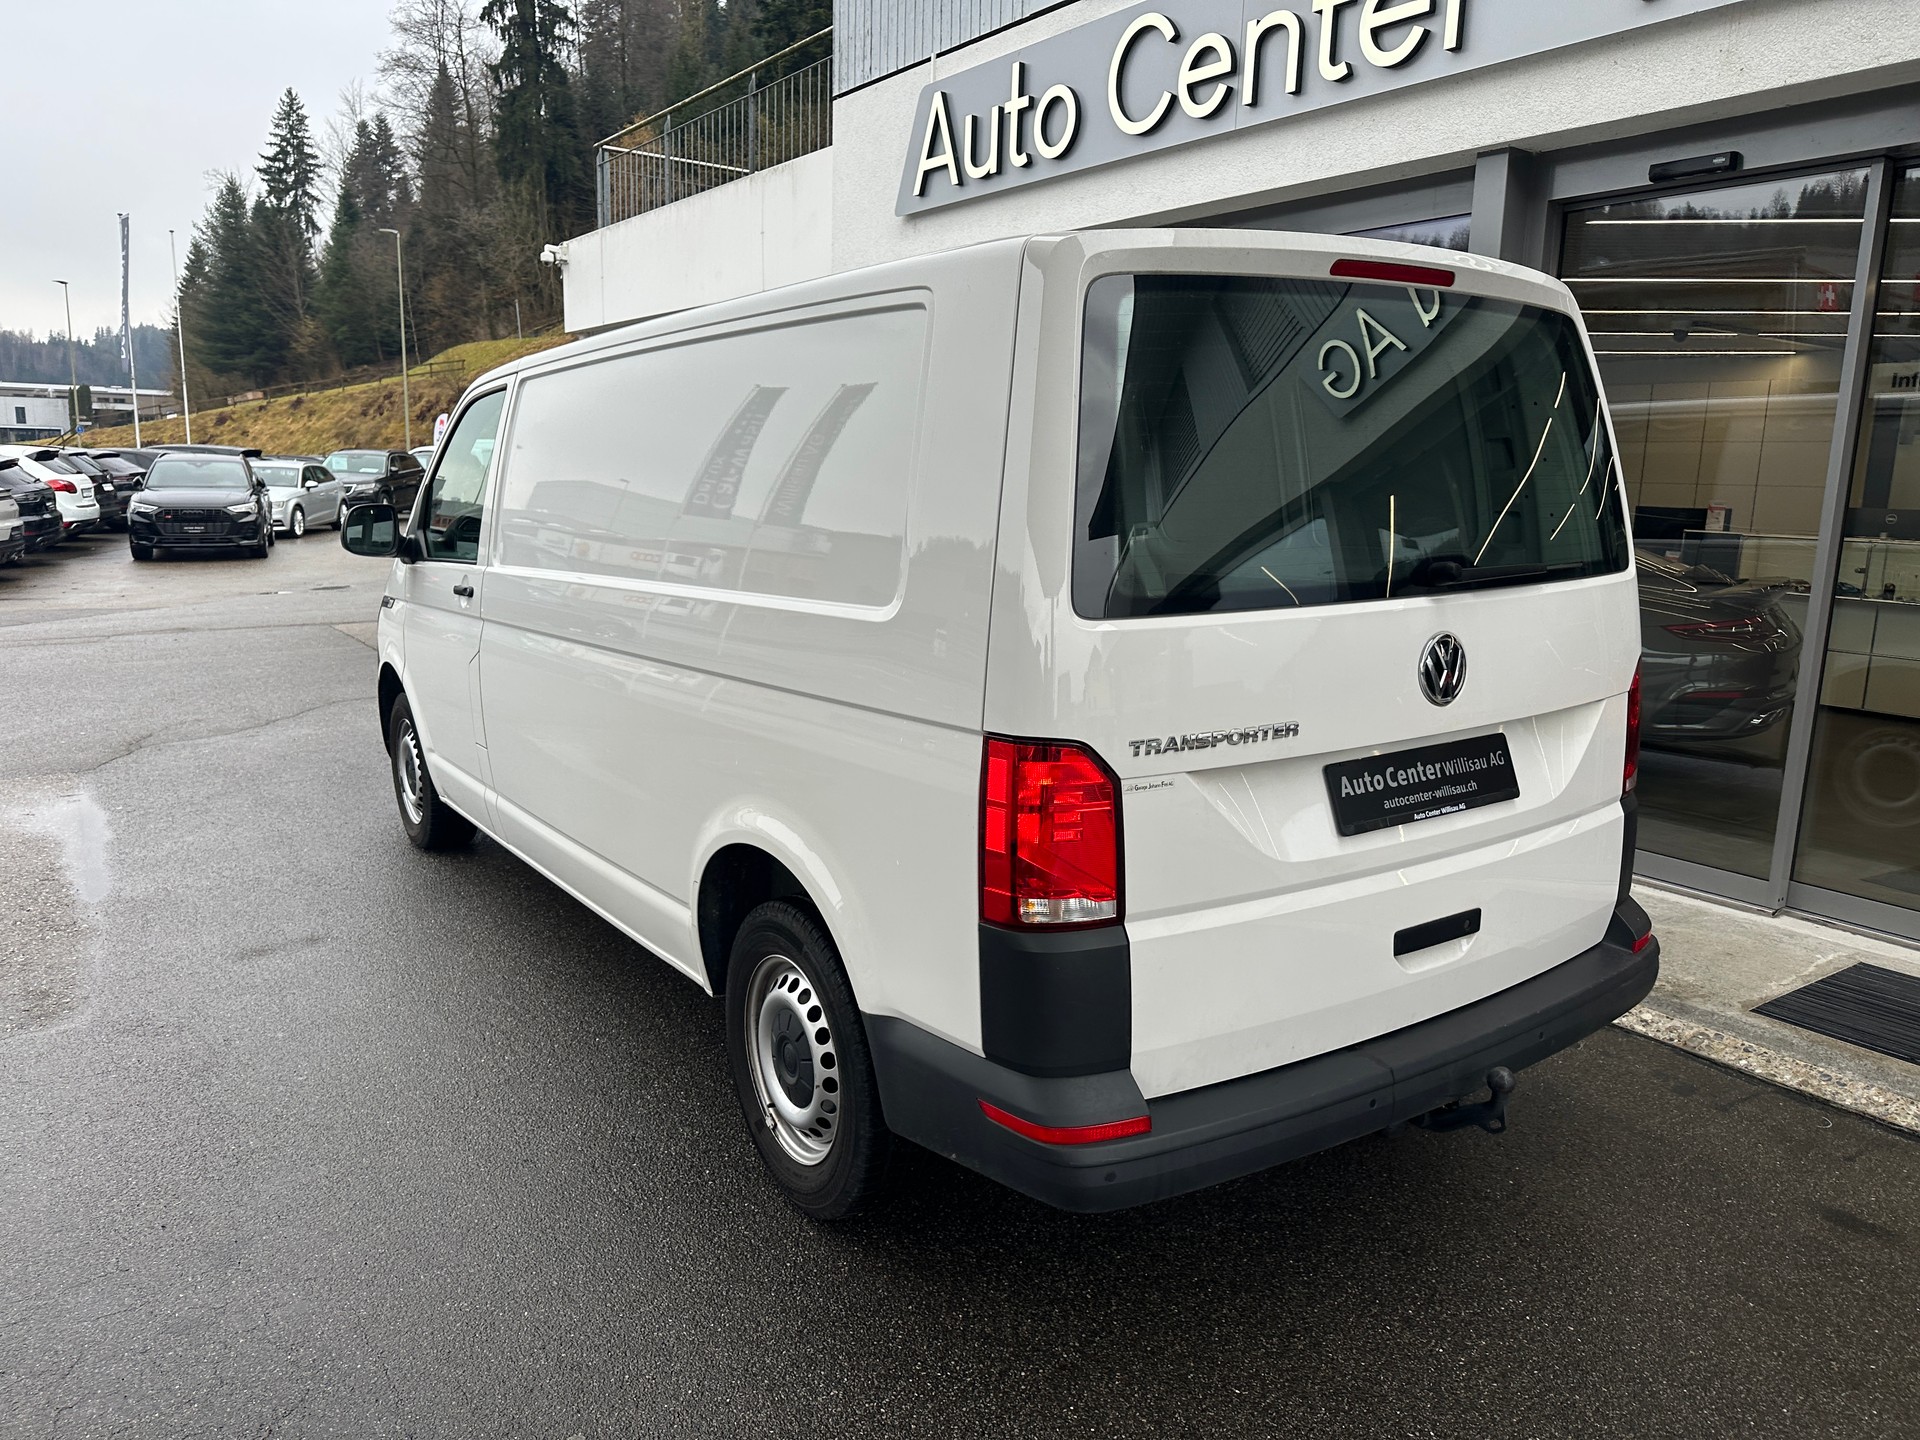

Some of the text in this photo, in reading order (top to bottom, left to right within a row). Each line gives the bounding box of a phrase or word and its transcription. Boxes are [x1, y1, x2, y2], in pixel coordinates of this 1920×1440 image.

[912, 61, 1081, 197] Auto
[1892, 372, 1920, 388] inf
[1128, 720, 1300, 758] TRANSPORTER
[1341, 750, 1505, 798] Auto Center Willisau AG
[1383, 779, 1478, 809] autocenter-willisau.ch
[1413, 803, 1466, 821] Auto Center Willisau AG
